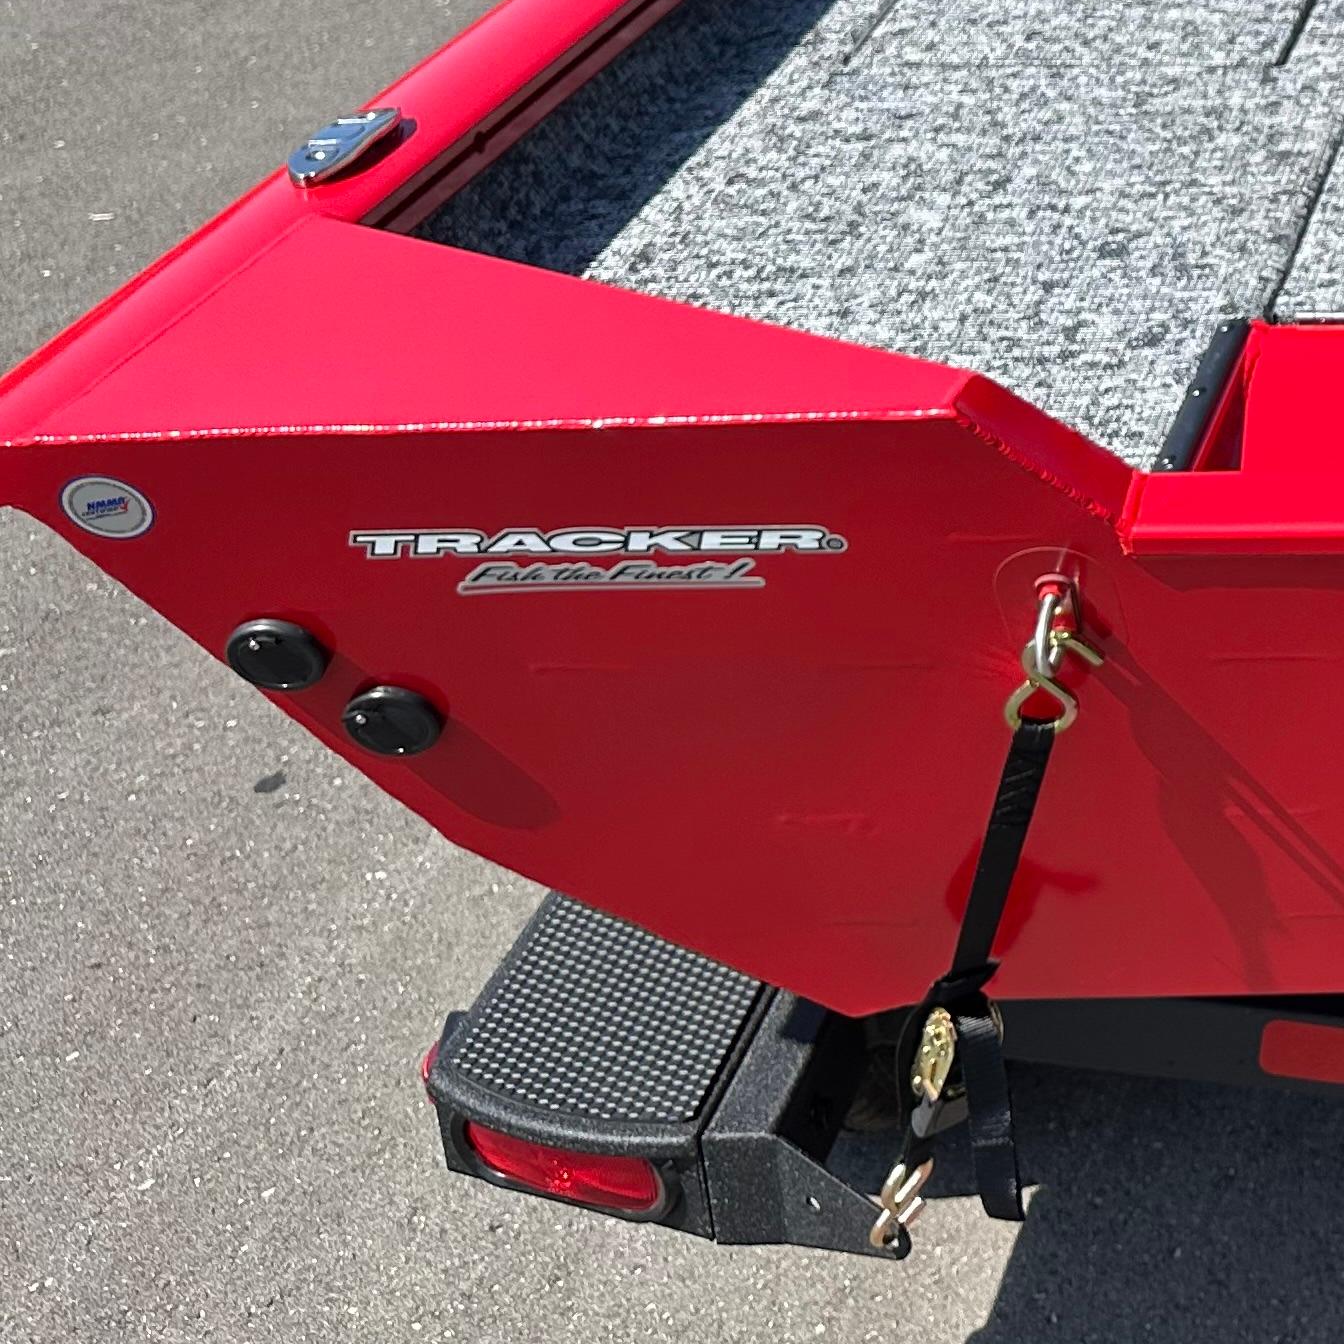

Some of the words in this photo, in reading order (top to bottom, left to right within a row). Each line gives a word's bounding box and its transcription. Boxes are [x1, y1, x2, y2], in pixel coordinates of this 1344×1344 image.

[352, 528, 830, 557] TRACKER
[470, 565, 547, 583] Fish
[549, 565, 602, 580] the
